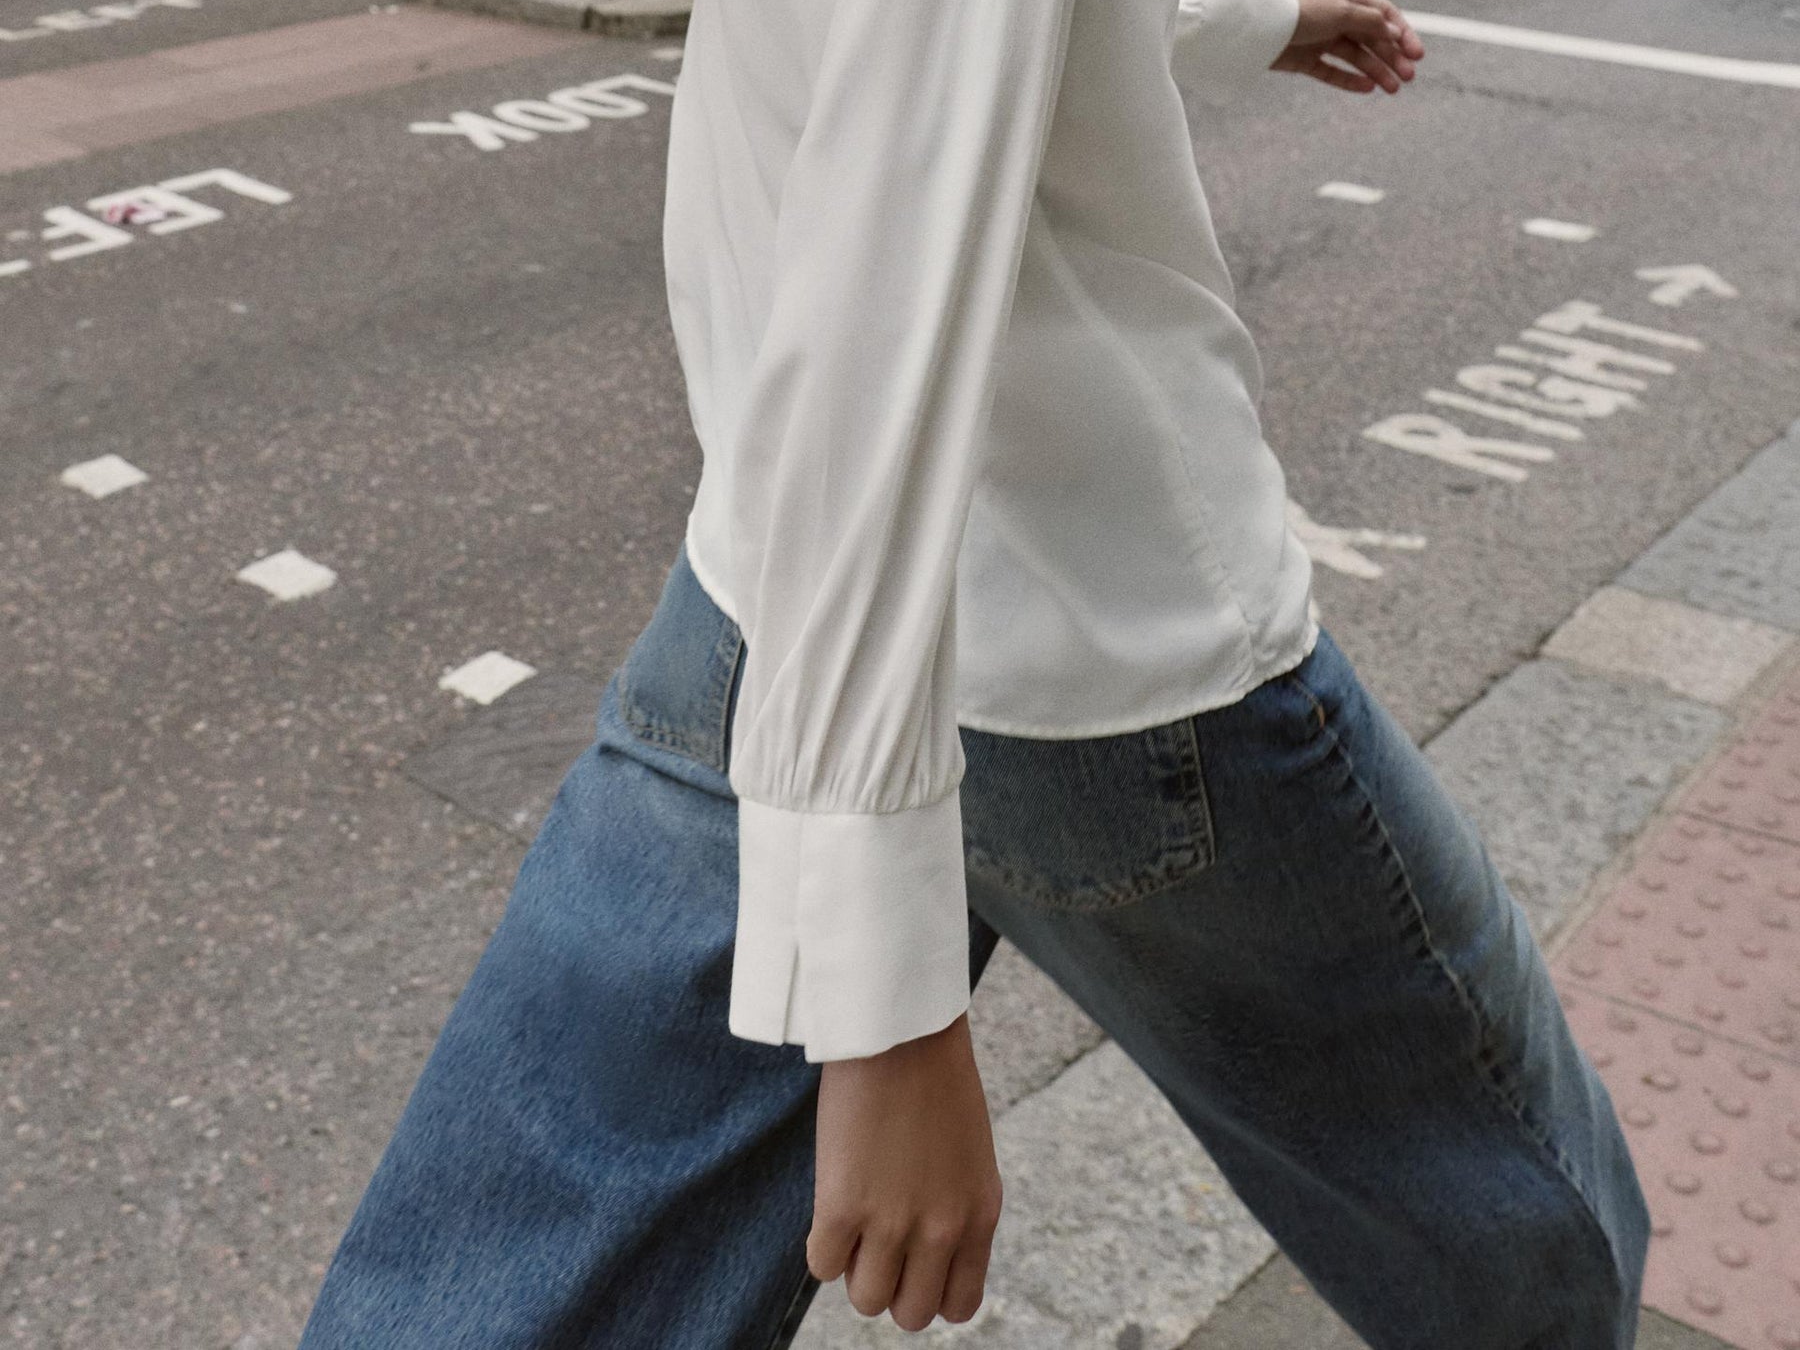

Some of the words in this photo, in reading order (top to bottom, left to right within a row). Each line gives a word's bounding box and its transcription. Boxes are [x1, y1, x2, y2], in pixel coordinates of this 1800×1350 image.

[408, 73, 676, 151] LOOK
[0, 168, 292, 277] LEF
[1362, 301, 1704, 482] RIGHT
